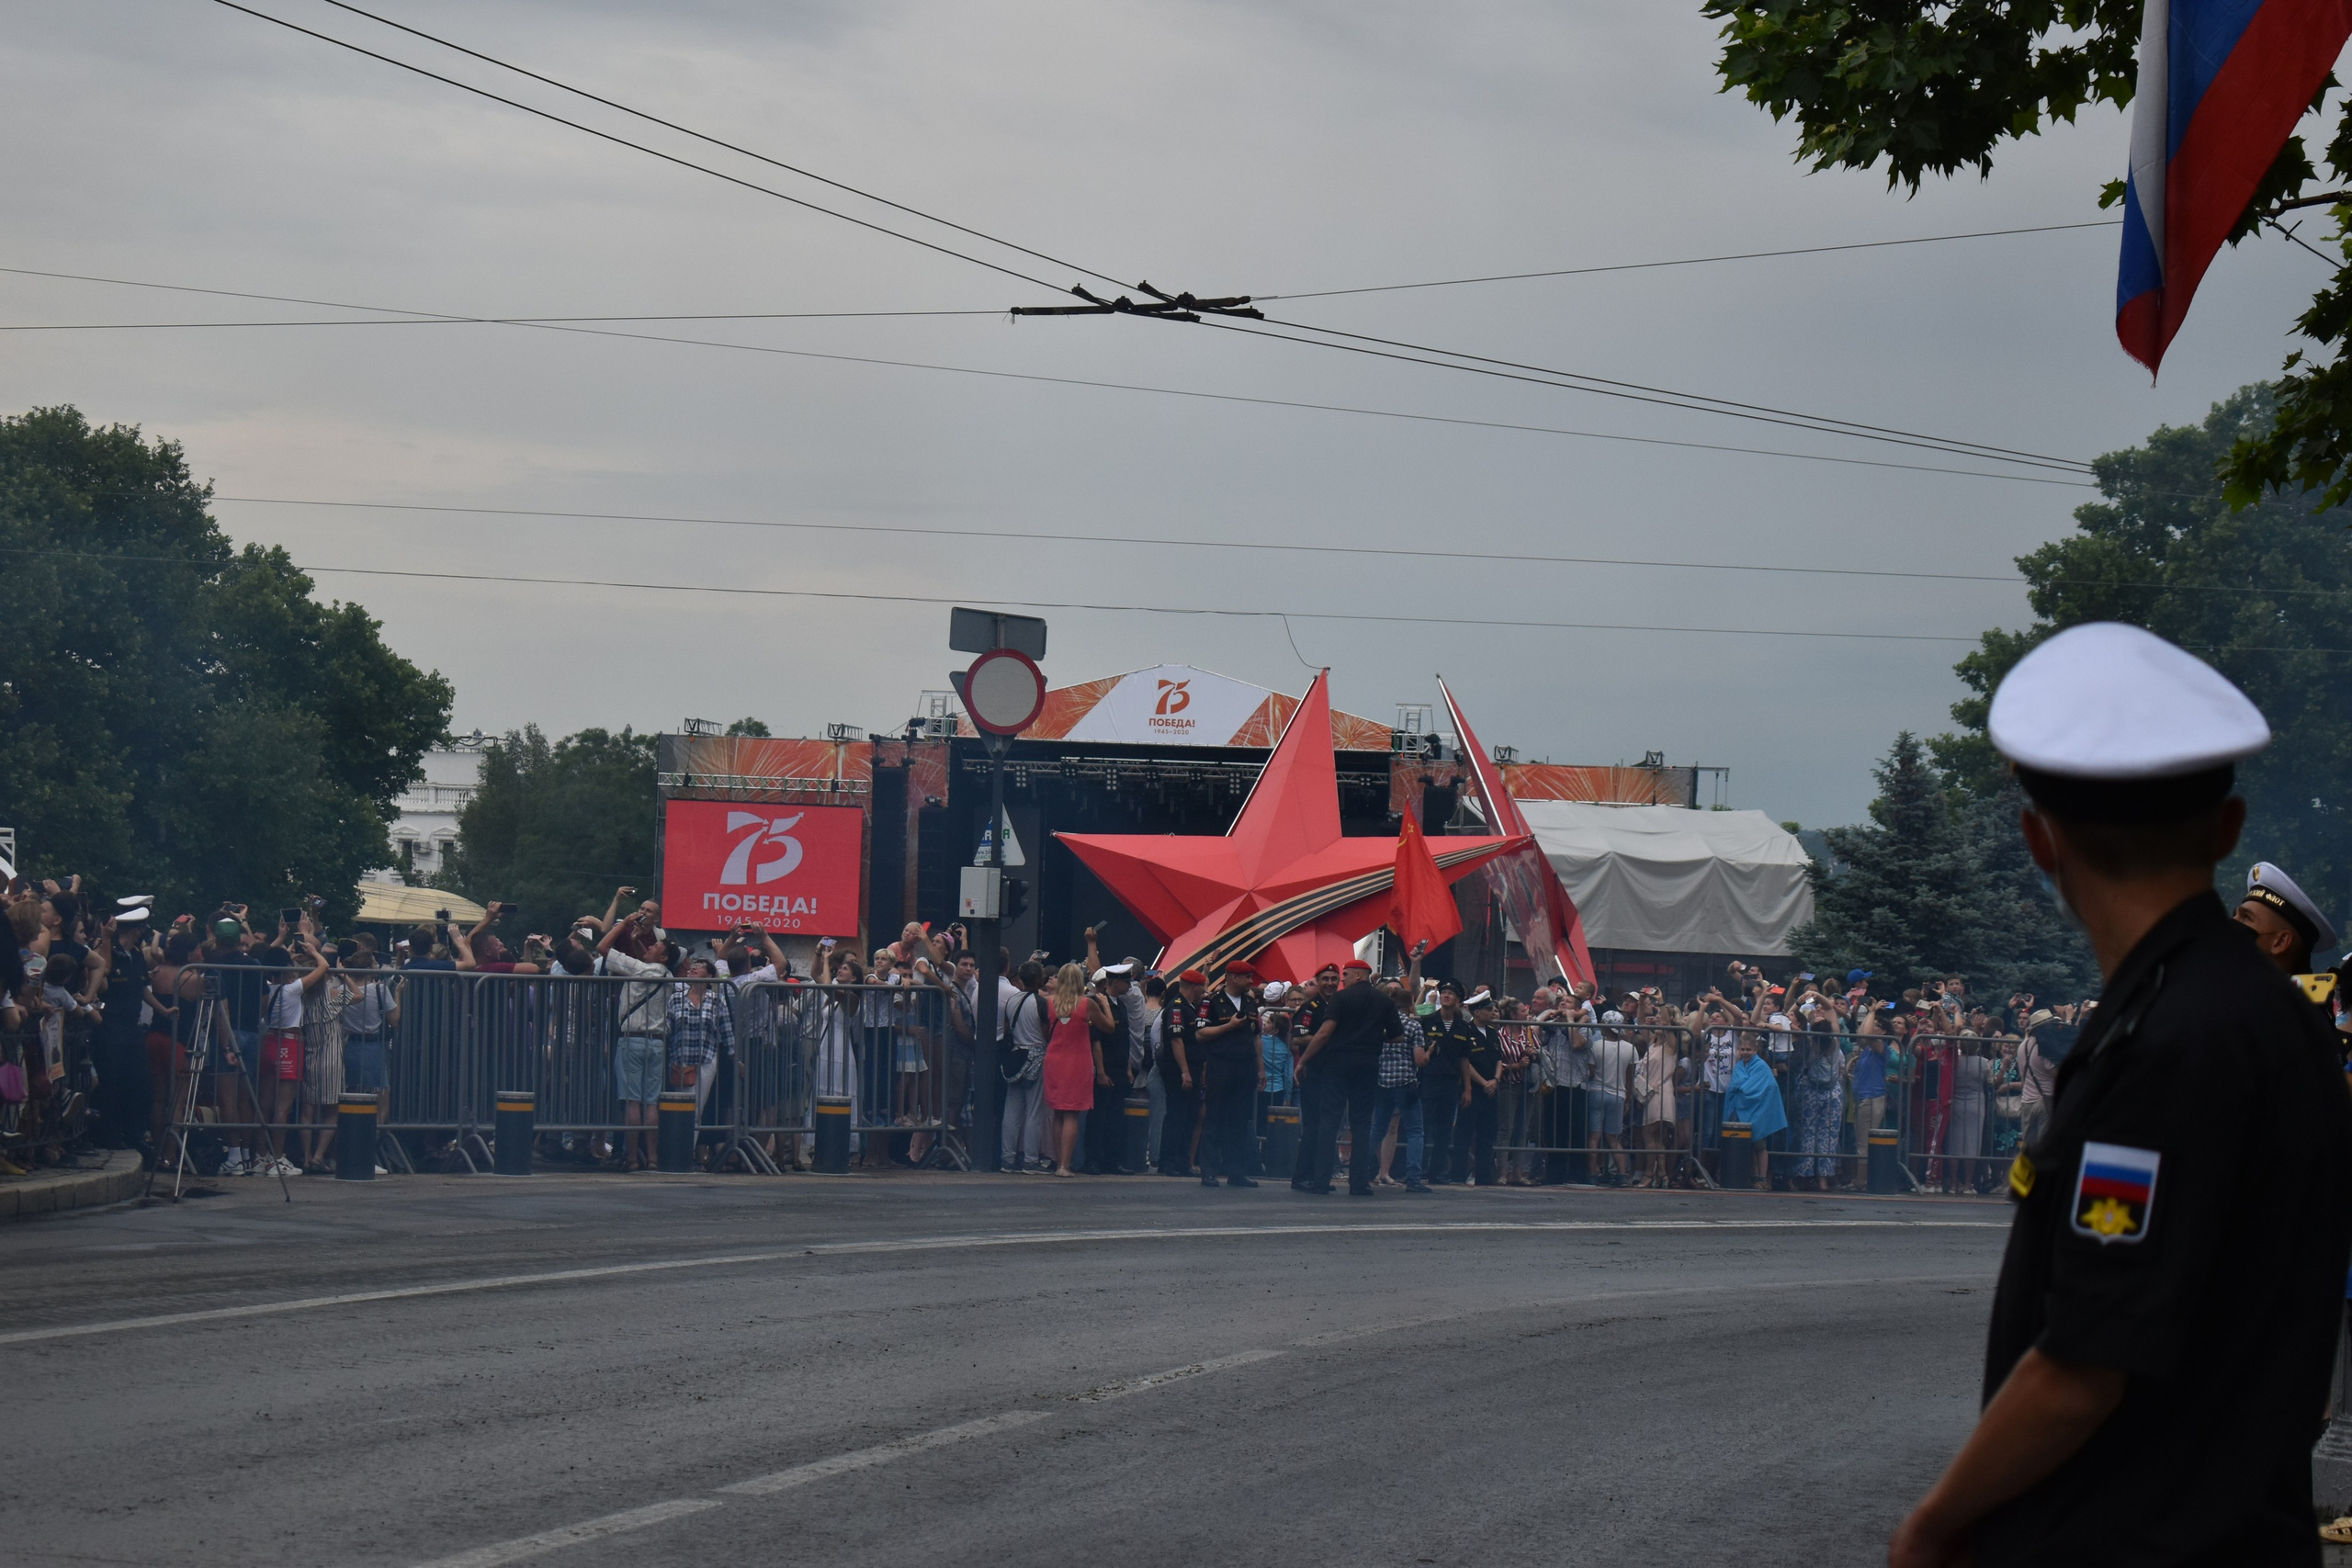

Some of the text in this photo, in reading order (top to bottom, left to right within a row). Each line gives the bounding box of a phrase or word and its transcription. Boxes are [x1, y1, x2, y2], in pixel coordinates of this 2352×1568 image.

[1155, 679, 1191, 715] 75
[1148, 717, 1195, 728] ПОБЕДА!
[720, 811, 804, 885] 75
[703, 893, 817, 916] ПОБЕДА!
[2265, 893, 2286, 907] ФЛОТ
